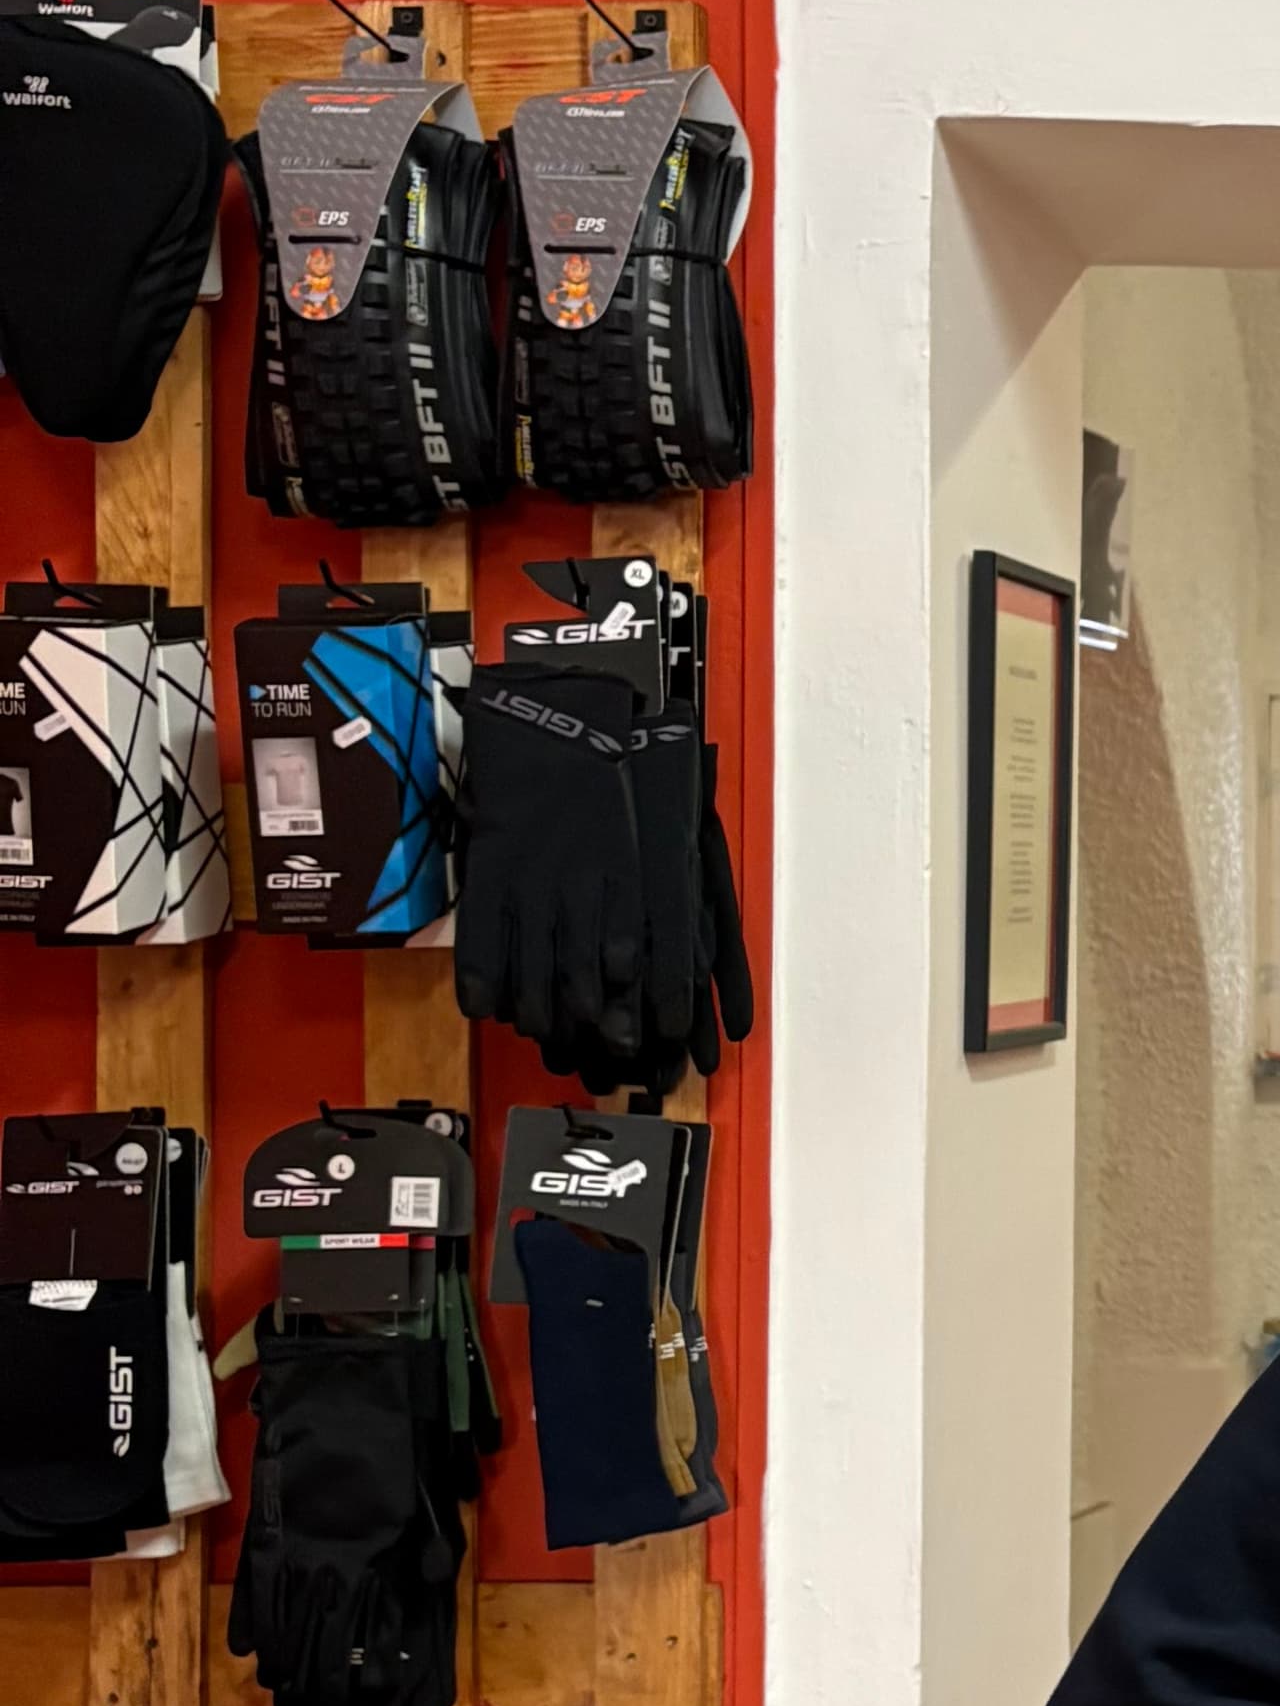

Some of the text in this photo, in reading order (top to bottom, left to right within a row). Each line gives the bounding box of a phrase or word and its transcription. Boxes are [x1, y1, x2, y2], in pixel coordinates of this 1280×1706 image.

[318, 210, 350, 226] EPS
[575, 217, 607, 233] EPS
[647, 336, 676, 426] BFT
[412, 378, 452, 464] BFT
[629, 567, 646, 581] XL
[0, 682, 26, 699] ME
[266, 683, 311, 701] TIME
[0, 700, 27, 716] UN
[251, 701, 312, 718] TO RUN
[481, 689, 585, 739] GIST
[266, 872, 341, 890] GIST
[27, 1180, 80, 1195] GIST
[252, 1187, 343, 1207] GIST
[109, 1345, 133, 1430] GIST
